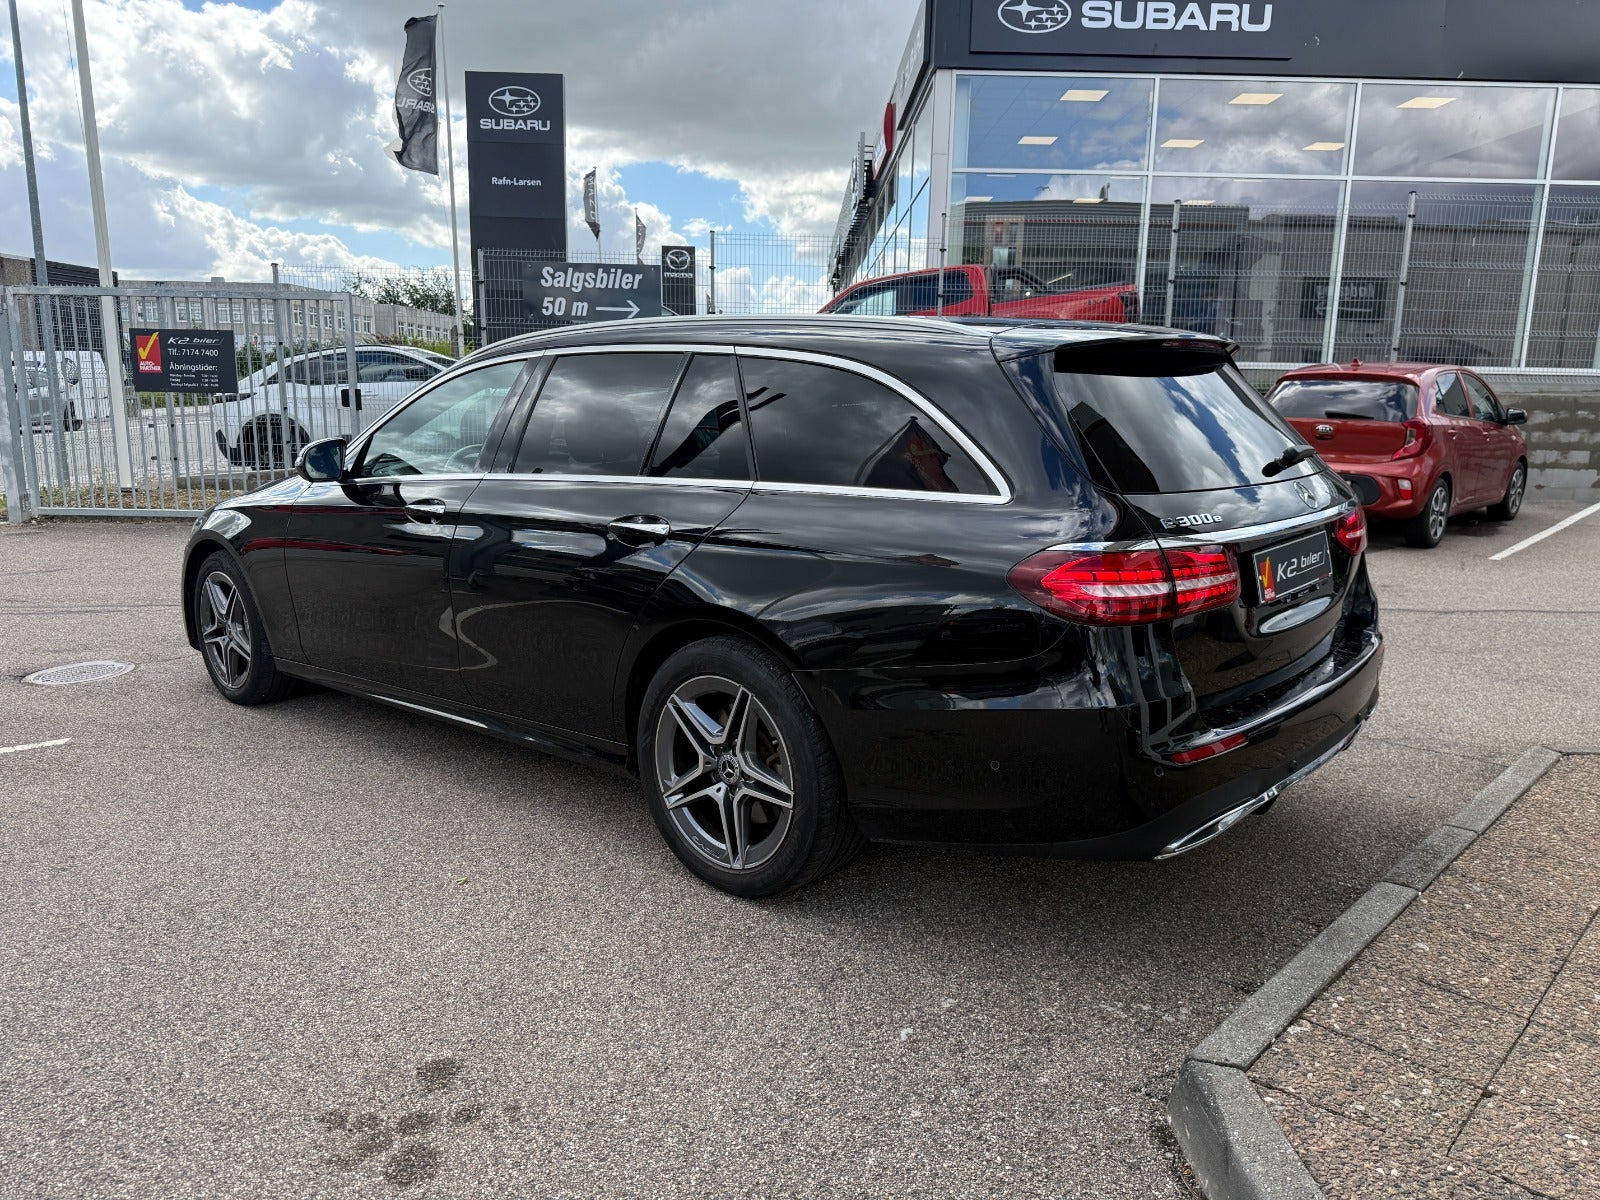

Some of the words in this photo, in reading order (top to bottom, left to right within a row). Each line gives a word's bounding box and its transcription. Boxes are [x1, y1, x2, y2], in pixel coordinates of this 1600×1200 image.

[1081, 1, 1273, 32] SUBARU
[479, 118, 550, 131] SUBARU
[491, 176, 542, 187] Rafn-Larsen
[540, 266, 643, 293] Salgsbiler
[541, 297, 567, 317] 50
[571, 301, 589, 317] m
[167, 336, 190, 345] K2
[167, 347, 181, 356] Tlf.:
[181, 348, 200, 356] 7174
[200, 348, 219, 357] 7400
[169, 361, 219, 373] Åbningstider:
[1277, 557, 1298, 582] K2
[1300, 551, 1322, 568] biler
